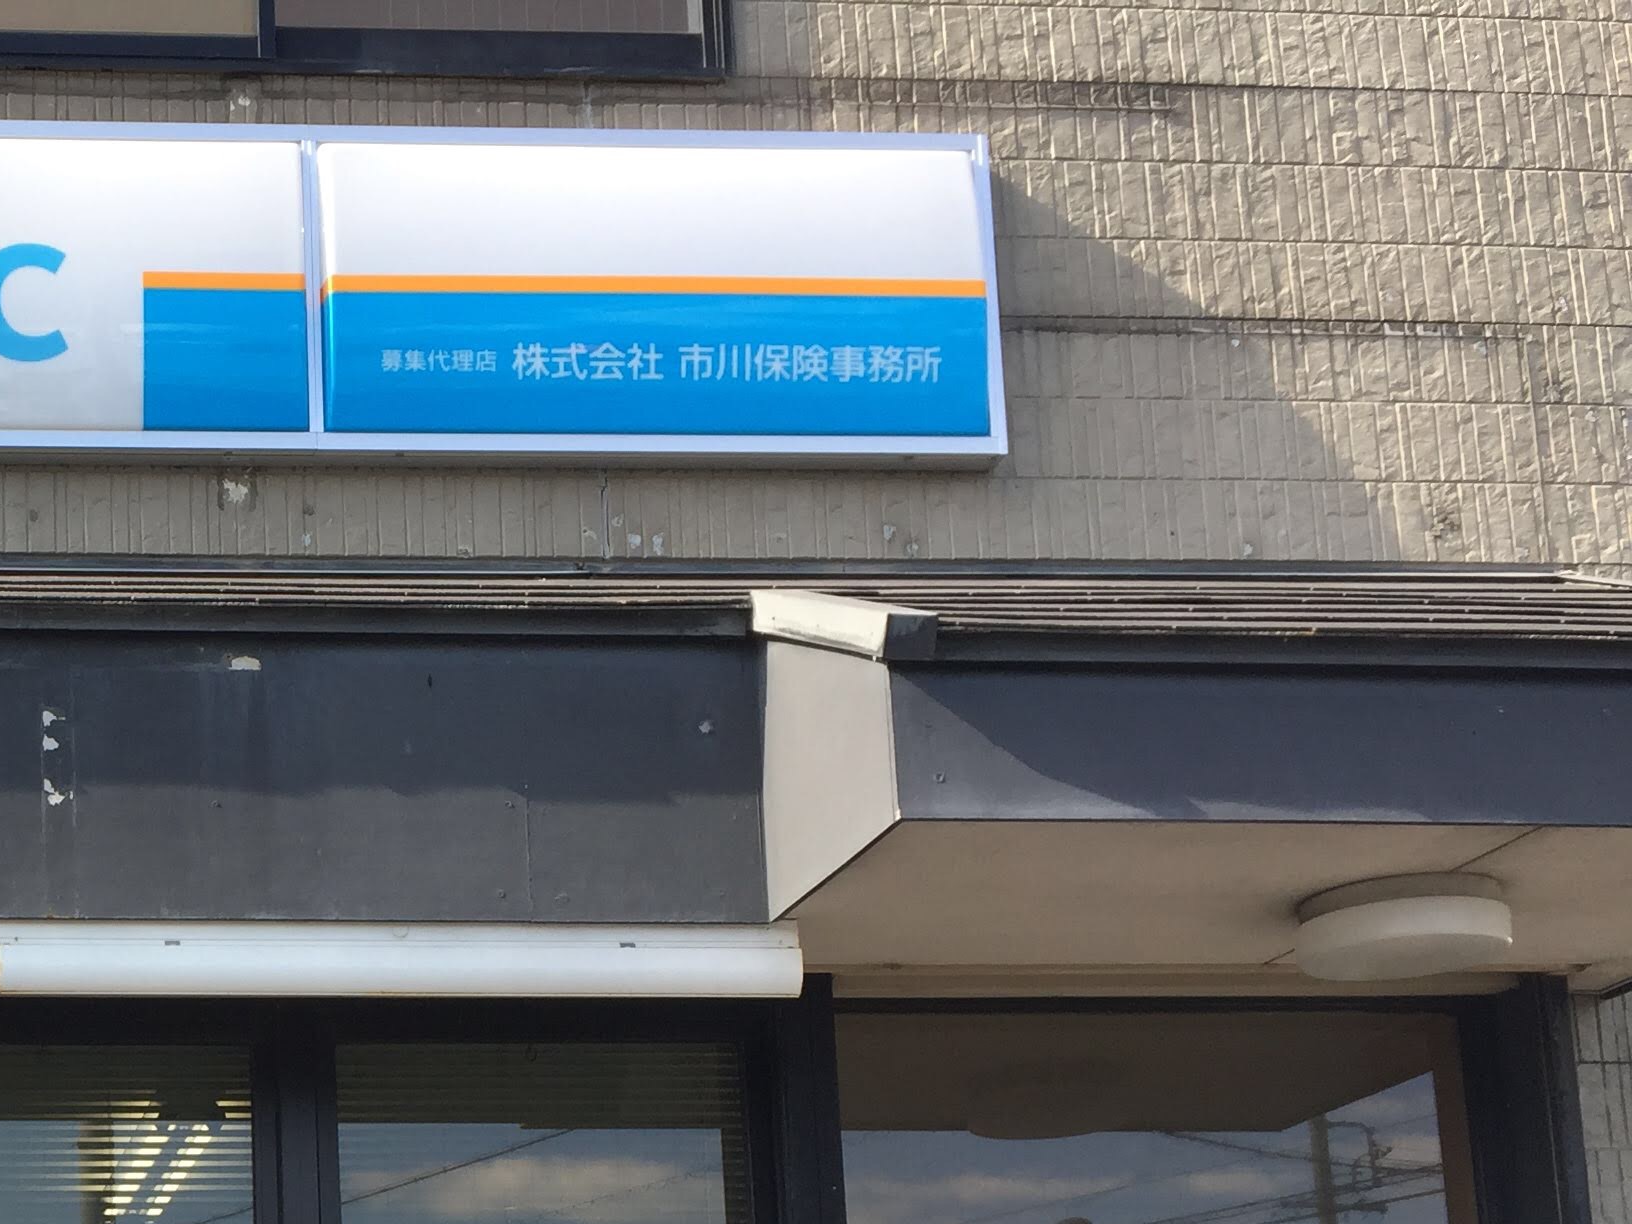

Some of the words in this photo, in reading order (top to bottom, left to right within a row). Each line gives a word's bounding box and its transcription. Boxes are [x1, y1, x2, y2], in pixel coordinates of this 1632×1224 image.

[381, 348, 497, 373] 募集代理店
[513, 343, 663, 382] 株式会社
[679, 344, 941, 384] 市川保険事務所
